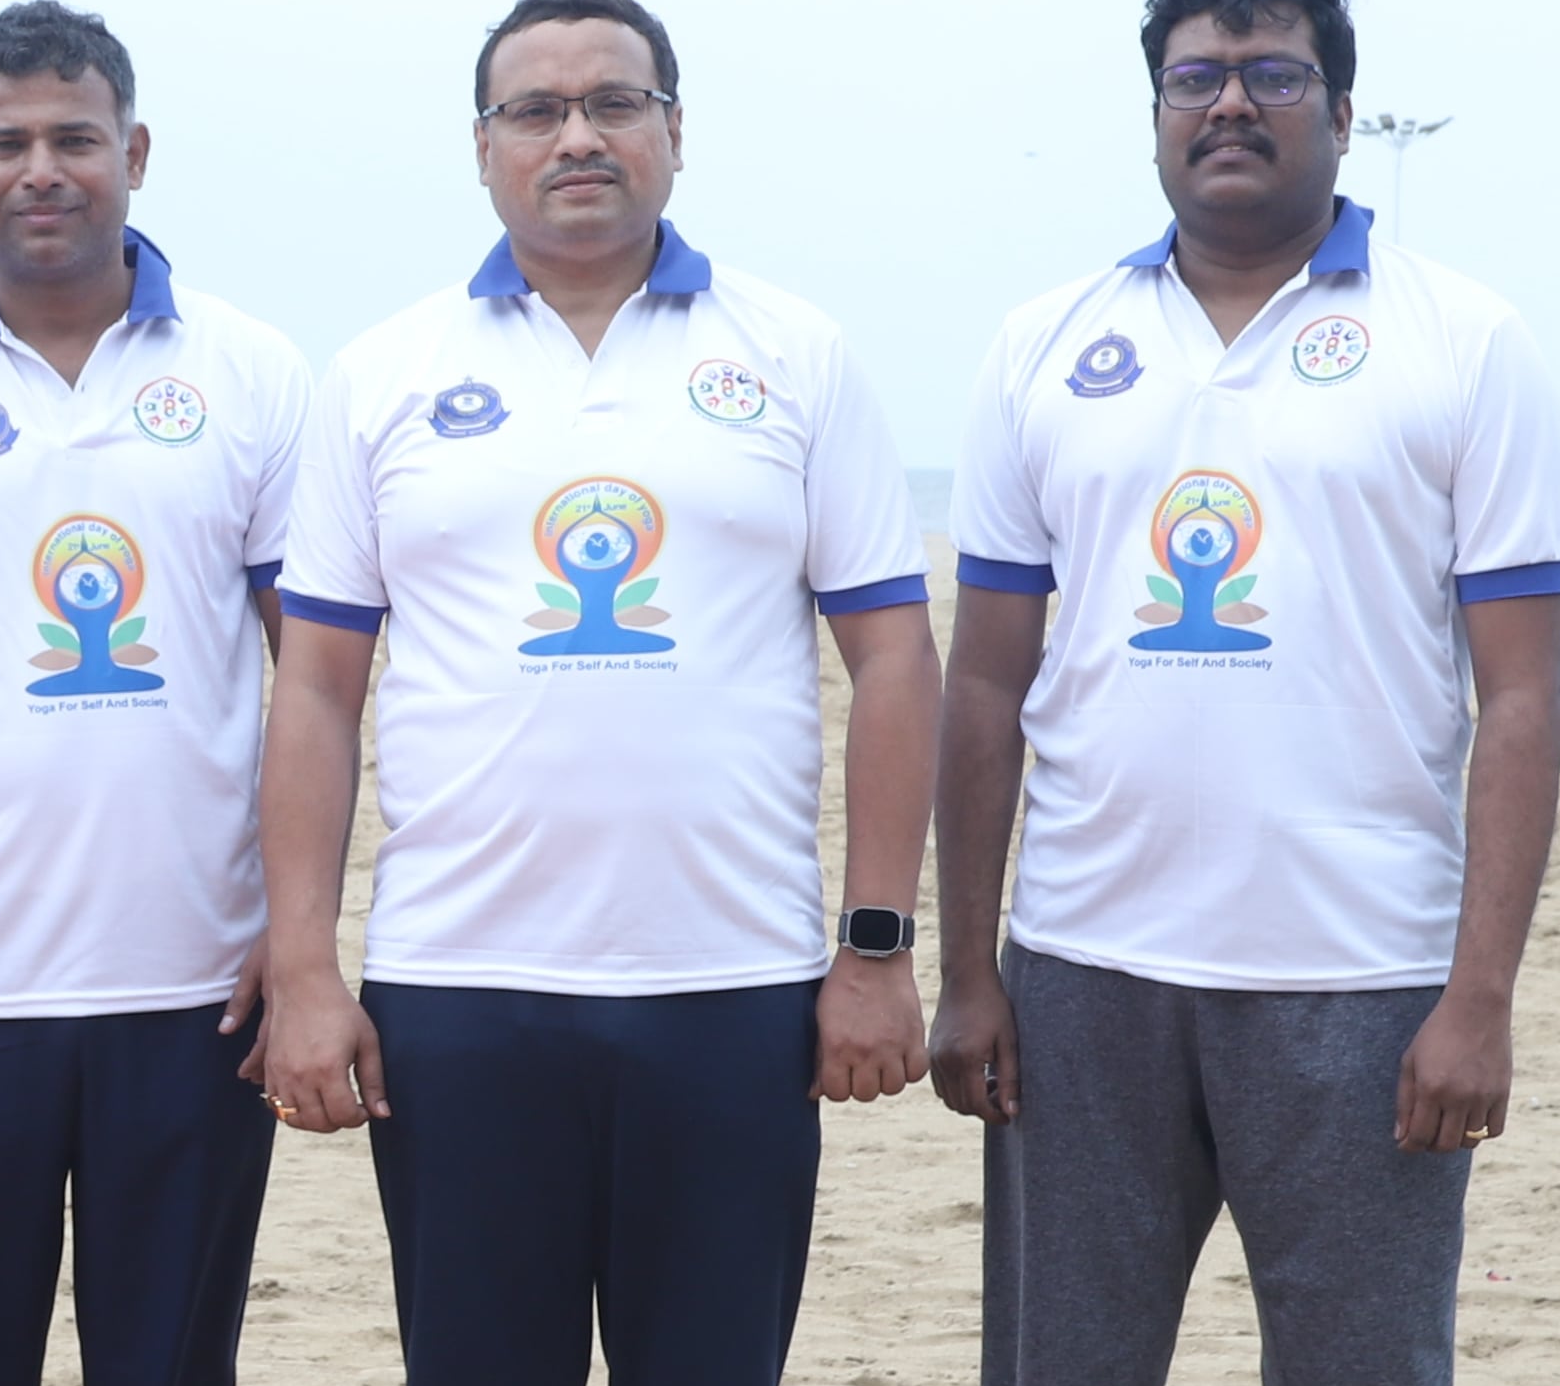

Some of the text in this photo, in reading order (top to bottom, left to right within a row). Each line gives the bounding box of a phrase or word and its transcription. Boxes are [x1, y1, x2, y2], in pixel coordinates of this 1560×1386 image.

[1213, 478, 1232, 492] day
[605, 483, 627, 496] day
[629, 492, 642, 504] of
[604, 503, 627, 511] June
[89, 523, 108, 536] day
[110, 533, 125, 544] of
[519, 659, 678, 674] Yoga For Self And Society
[1128, 657, 1274, 671] Yoga For Self And Society
[27, 697, 168, 715] Yoga For Self And Society
